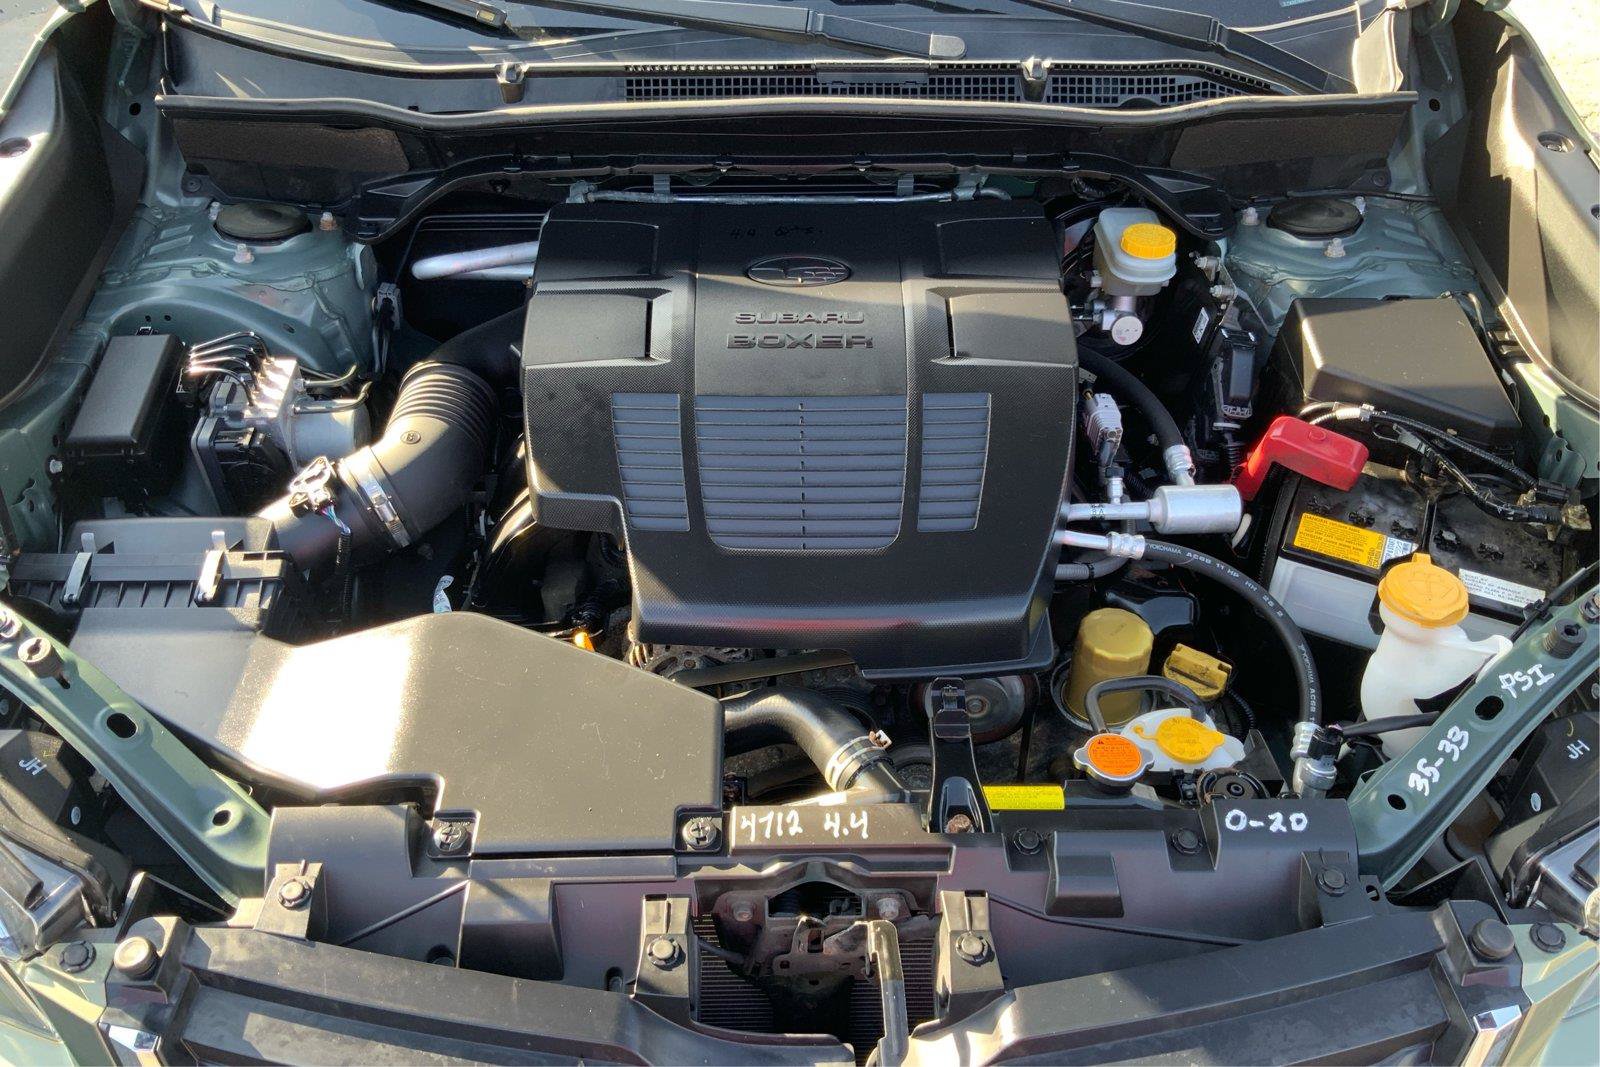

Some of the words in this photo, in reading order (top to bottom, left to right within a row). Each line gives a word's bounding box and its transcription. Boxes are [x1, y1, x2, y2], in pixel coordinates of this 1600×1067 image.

[736, 311, 865, 325] SUBARU
[727, 332, 874, 350] BOXER
[1148, 543, 1183, 555] YOKOHAMA
[1408, 725, 1469, 797] 35-33
[1499, 663, 1555, 699] PSI
[1567, 739, 1591, 760] JH
[18, 756, 48, 776] JH
[740, 809, 804, 843] 4712
[823, 810, 869, 840] 4.4
